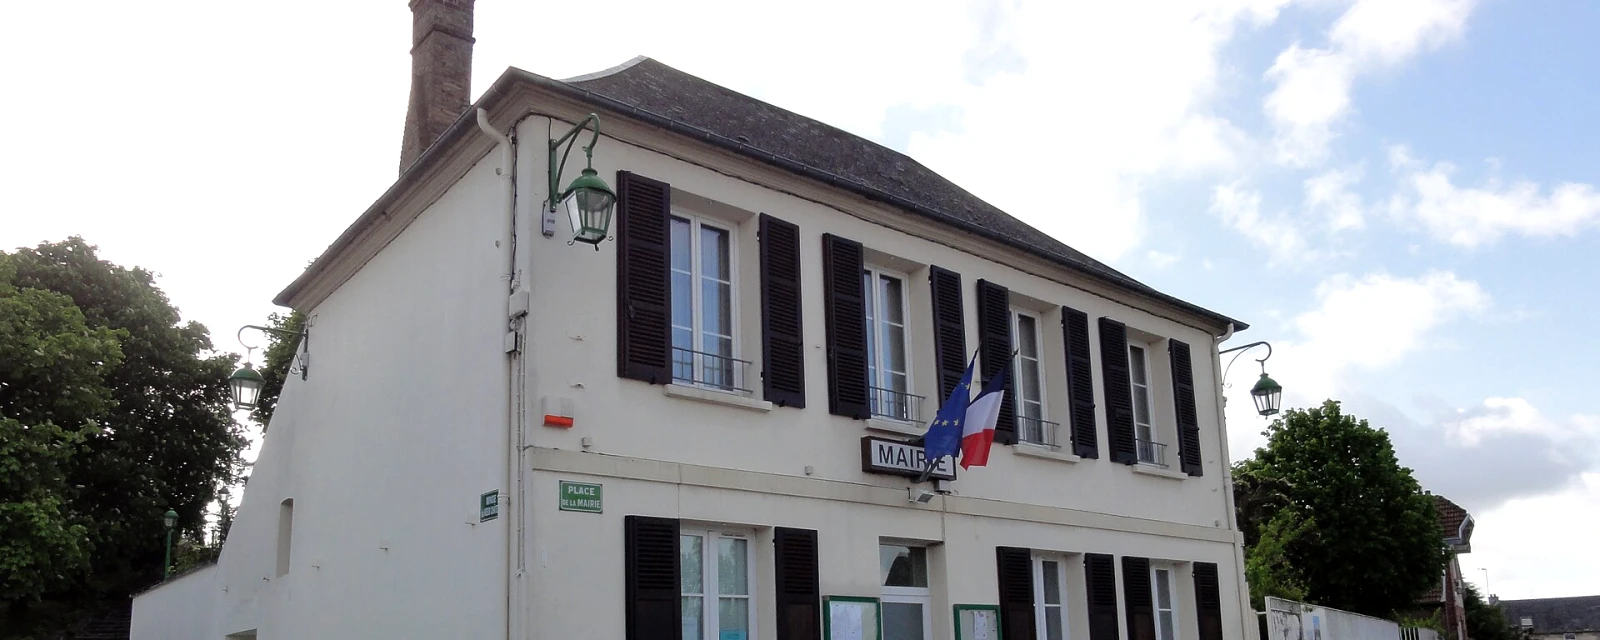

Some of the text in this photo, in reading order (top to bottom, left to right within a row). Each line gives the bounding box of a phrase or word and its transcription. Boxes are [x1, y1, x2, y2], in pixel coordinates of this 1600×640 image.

[878, 443, 947, 472] MAIRE
[568, 485, 595, 496] PLACE
[562, 498, 600, 508] DE LA MAIRIE
